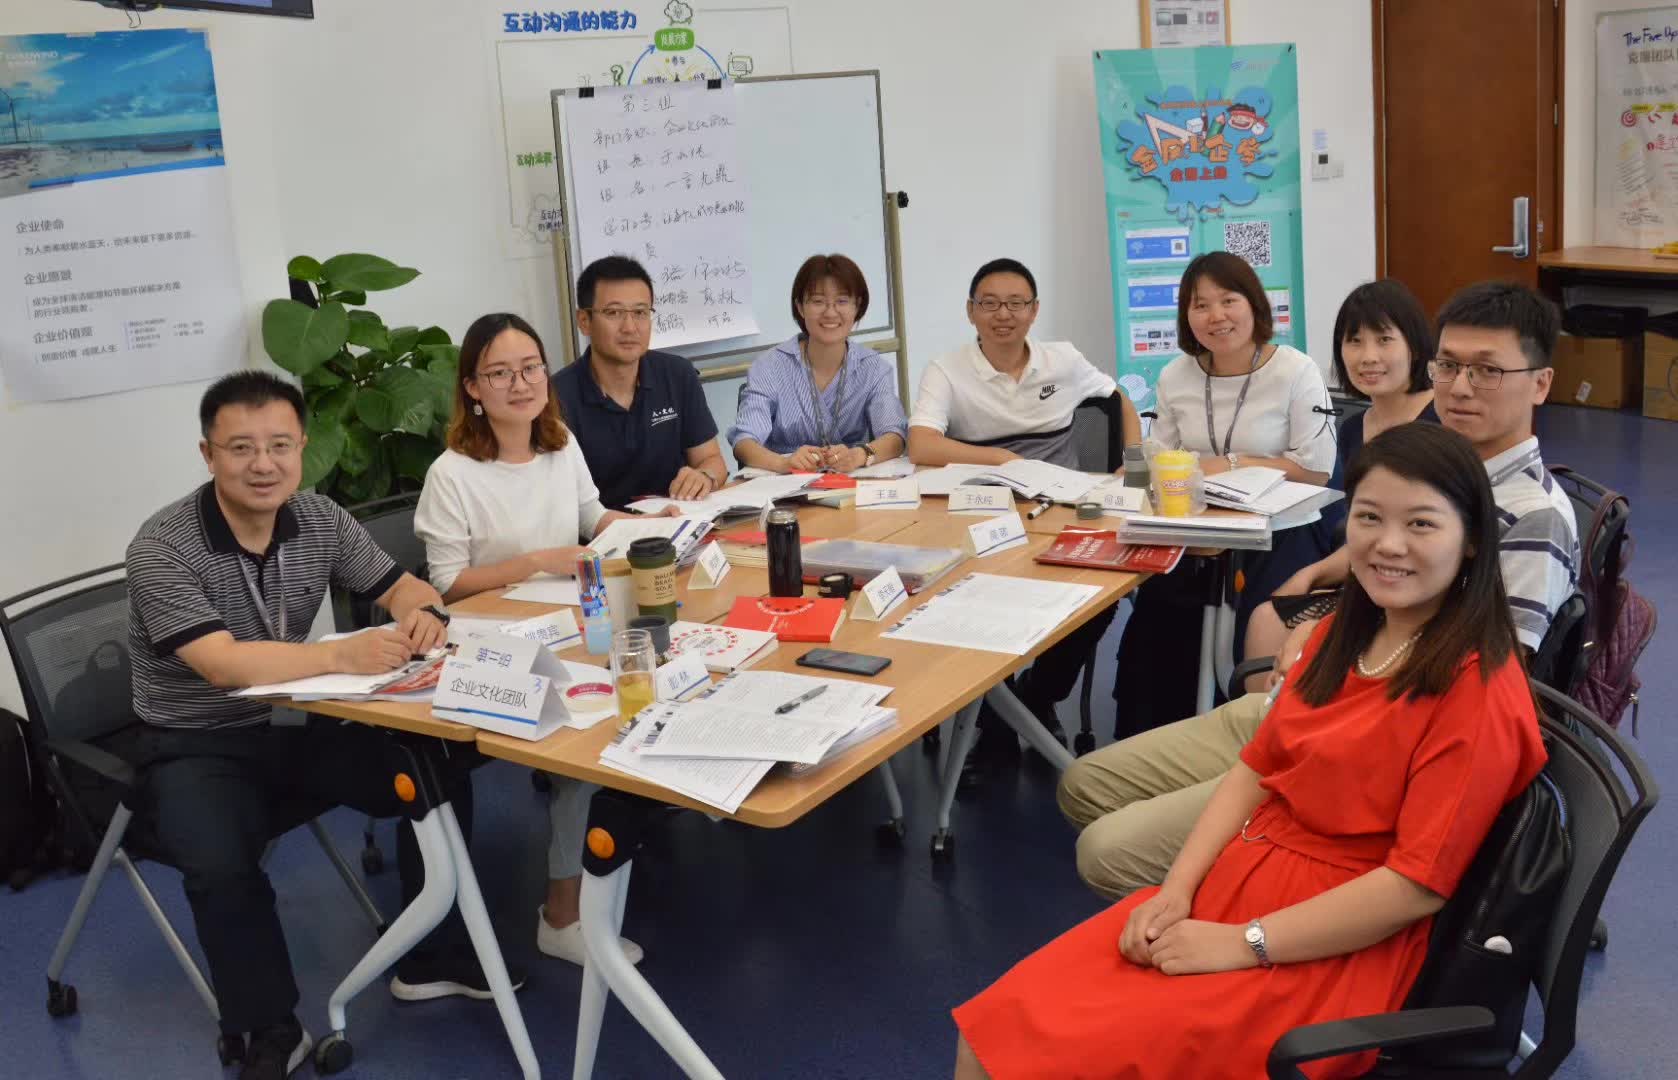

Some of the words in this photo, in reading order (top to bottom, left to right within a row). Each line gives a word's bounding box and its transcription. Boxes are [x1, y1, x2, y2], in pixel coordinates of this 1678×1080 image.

[502, 9, 637, 34] 互动沟通的能力
[16, 218, 65, 234] 企业使命
[1041, 384, 1056, 395] NIKE
[450, 677, 527, 709] 企业文化团队
[533, 676, 543, 695] 3
